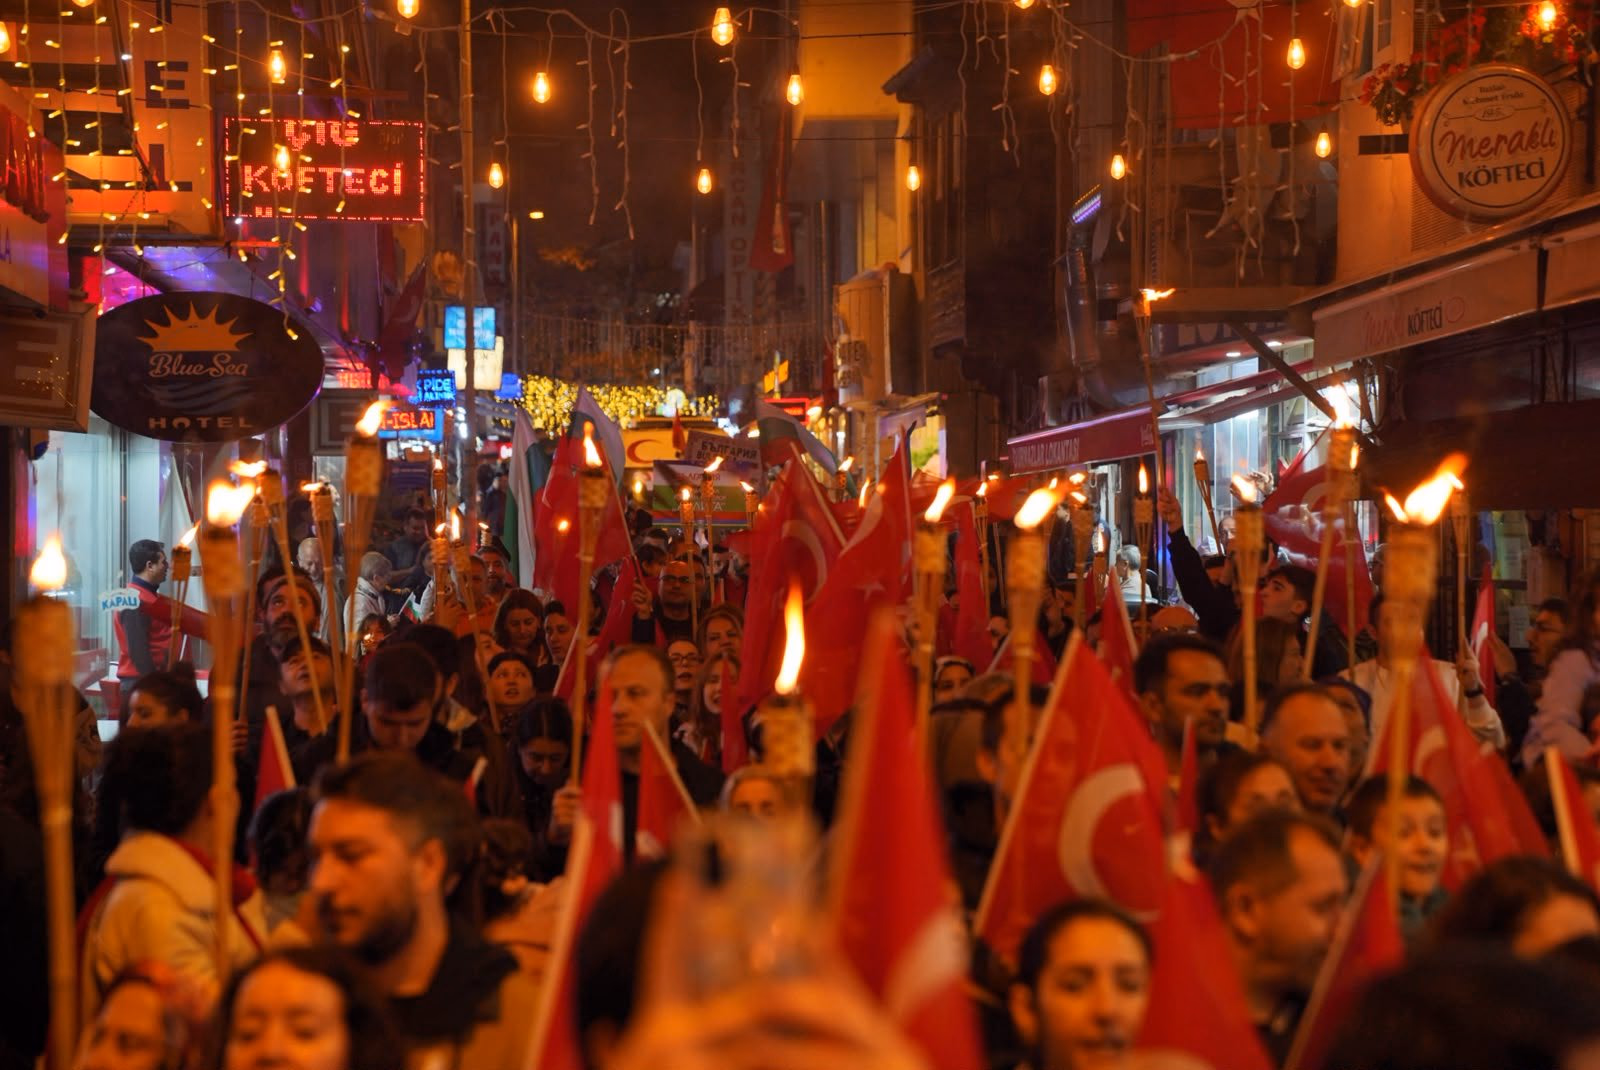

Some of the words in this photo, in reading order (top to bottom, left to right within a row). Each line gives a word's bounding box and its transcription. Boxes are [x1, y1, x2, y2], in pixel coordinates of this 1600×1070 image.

[1457, 157, 1546, 189] KÖFTECİ
[148, 352, 208, 378] Blue
[208, 352, 249, 378] Sea
[148, 416, 254, 430] HOTEL
